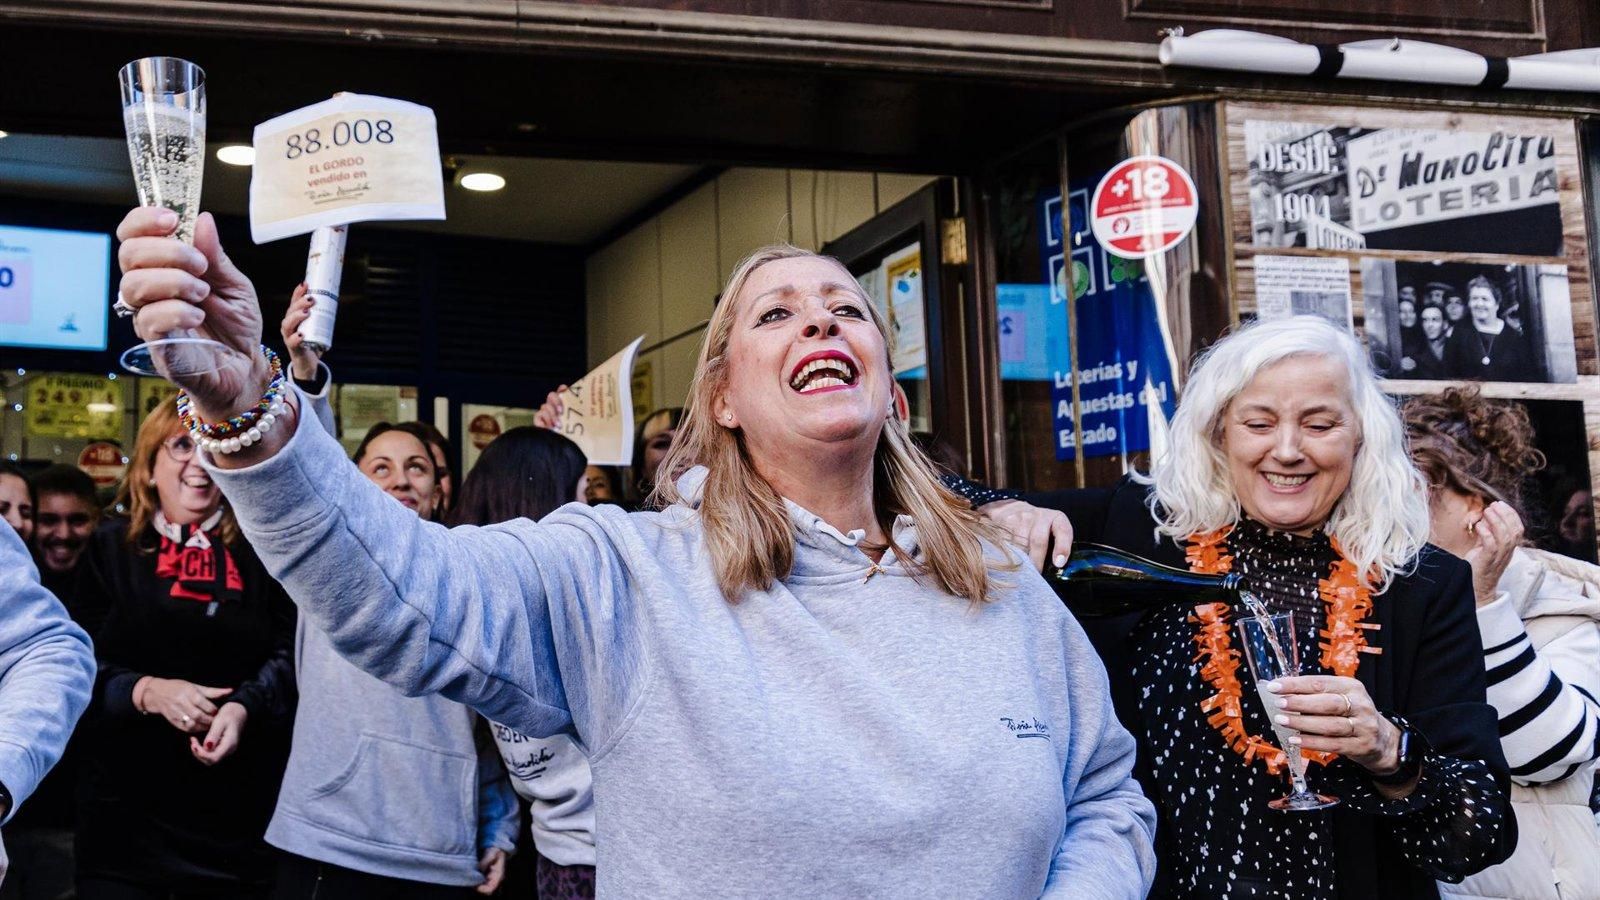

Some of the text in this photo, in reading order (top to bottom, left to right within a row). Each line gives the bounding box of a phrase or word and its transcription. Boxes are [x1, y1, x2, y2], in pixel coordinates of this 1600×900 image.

[286, 119, 394, 160] 88.008
[307, 170, 368, 188] vendido en
[309, 155, 365, 175] EL GORDO
[1111, 165, 1170, 202] +18
[1357, 167, 1559, 226] LOTERIA
[1274, 192, 1331, 223] 1904
[1126, 359, 1138, 382] y
